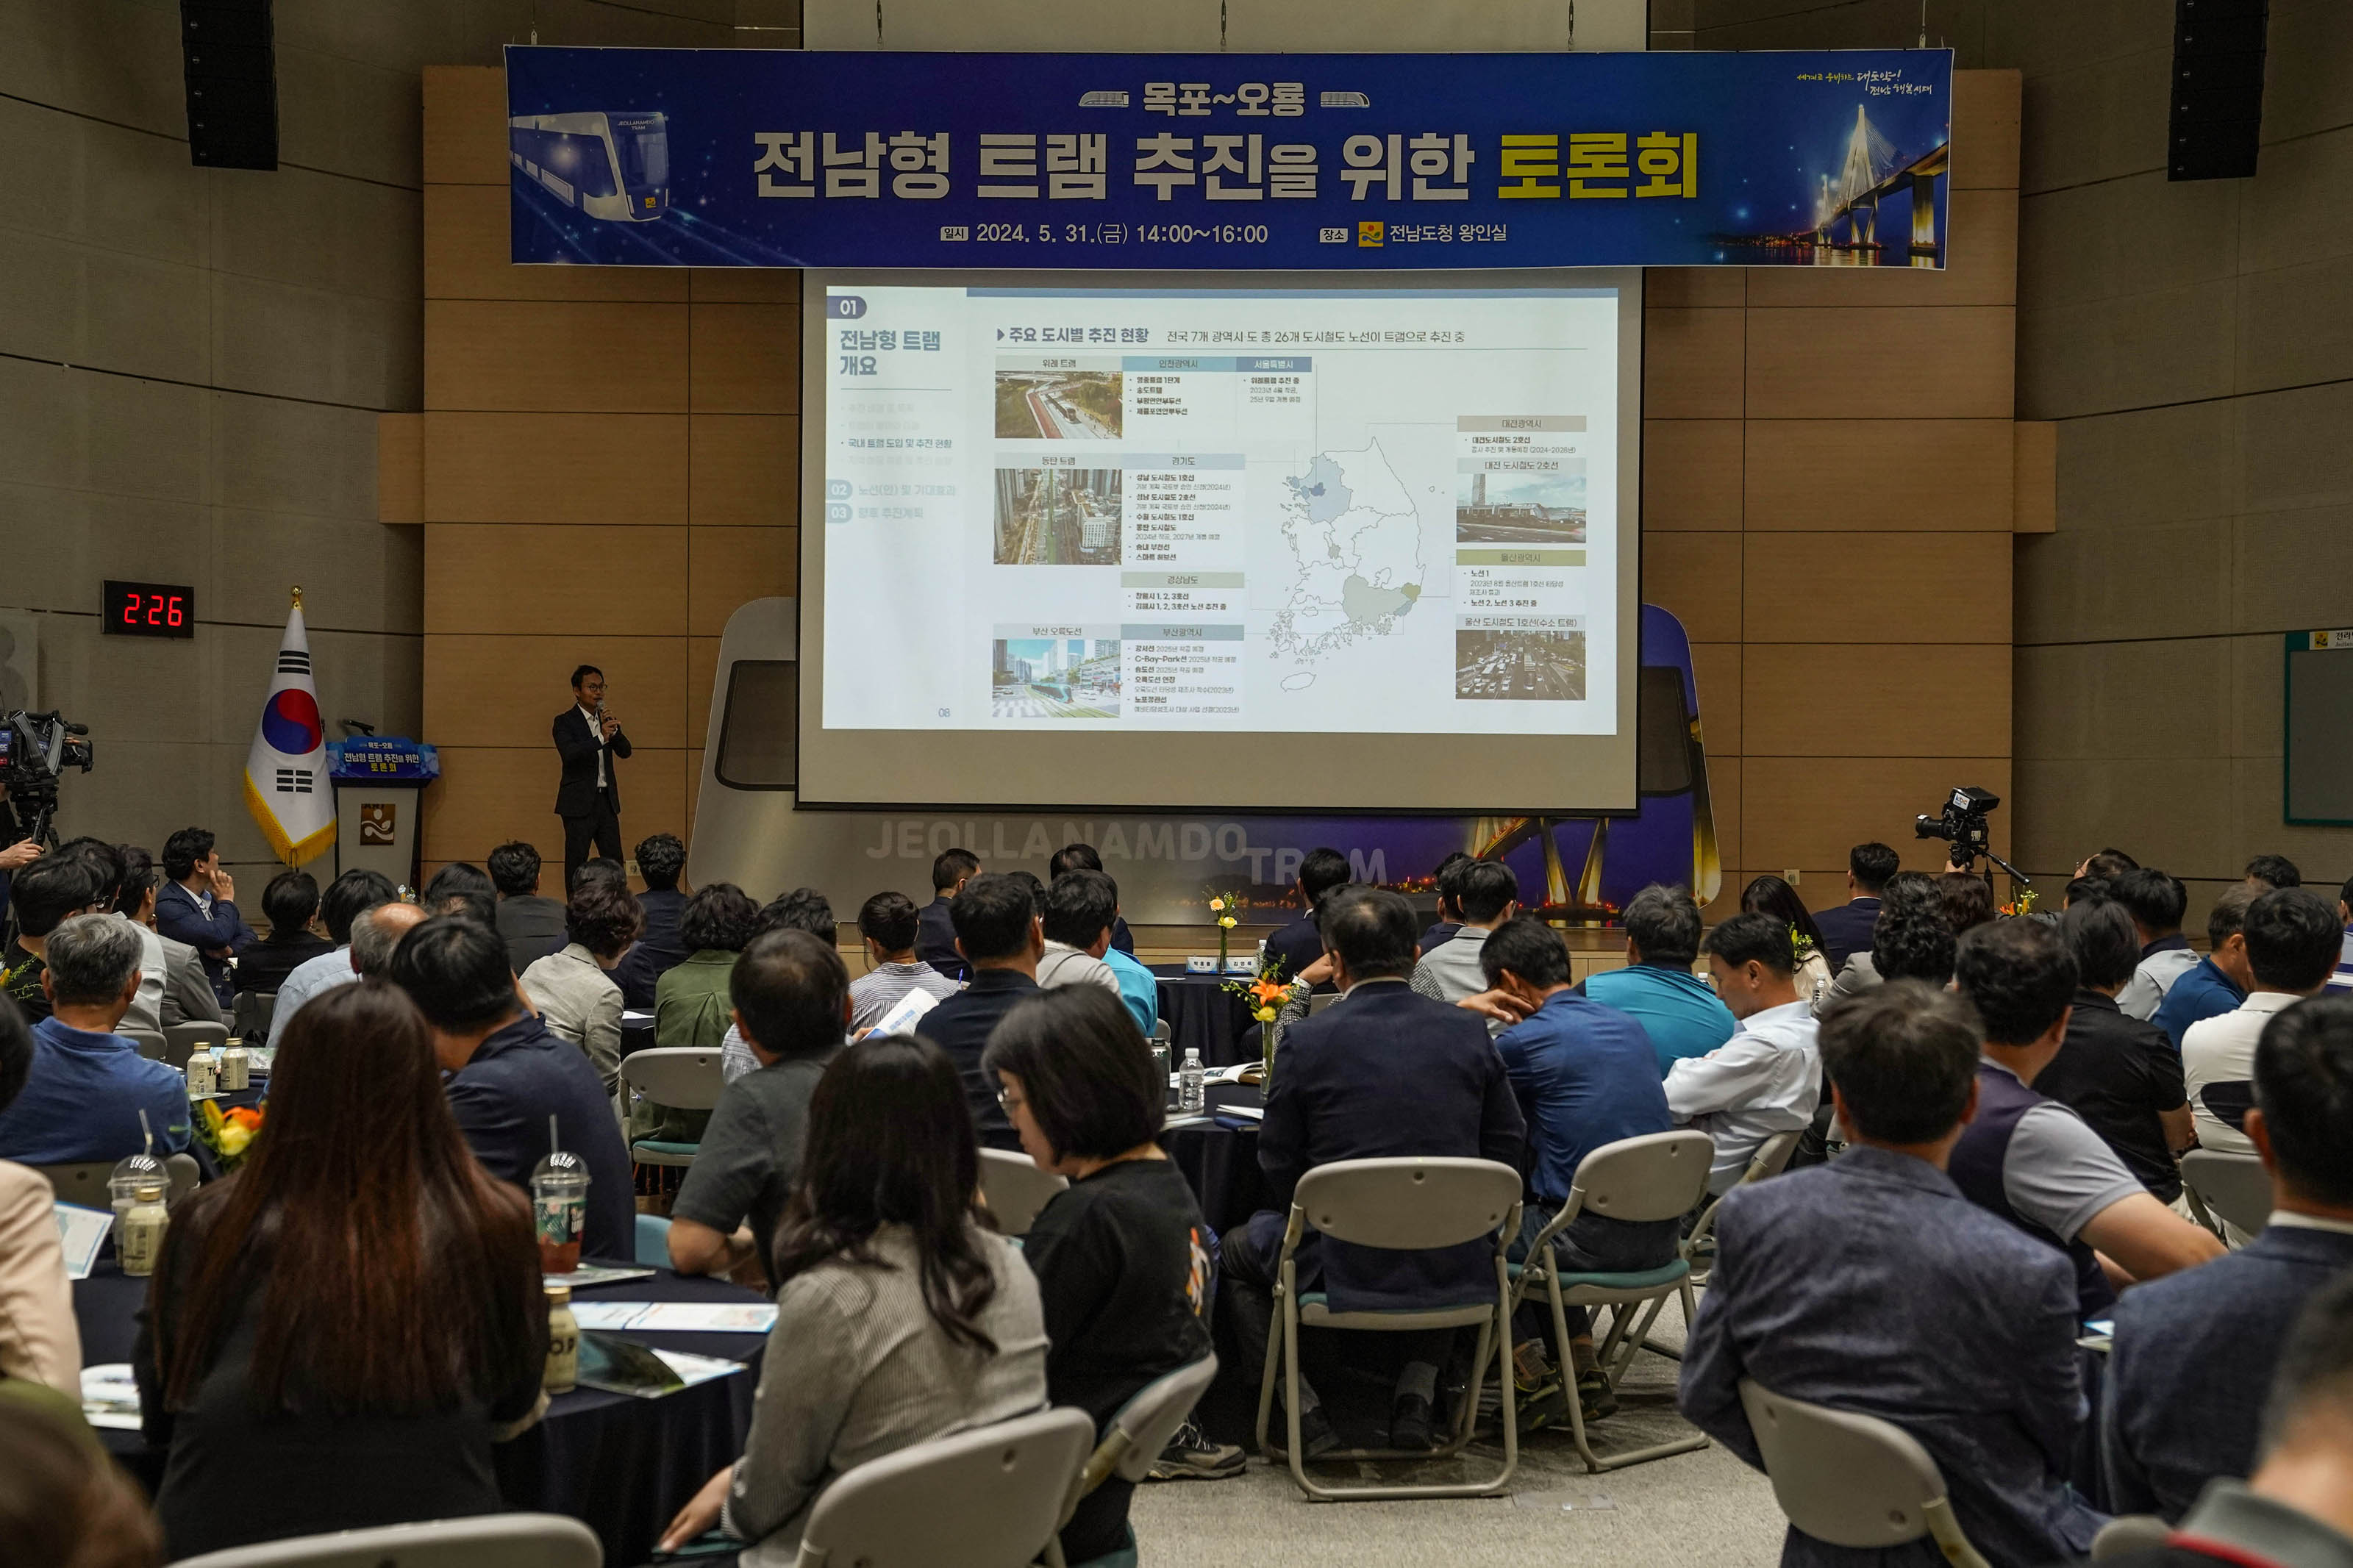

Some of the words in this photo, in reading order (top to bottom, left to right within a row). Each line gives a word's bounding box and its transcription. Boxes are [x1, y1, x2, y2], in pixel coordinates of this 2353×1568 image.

[1142, 82, 1305, 118] 목포~오룡
[752, 131, 951, 201] 전남형
[977, 131, 1107, 201] 트램
[1132, 131, 1318, 201] 추진을
[1340, 131, 1474, 201] 위한
[1497, 131, 1699, 201] 토론회
[943, 227, 965, 240] 일시
[976, 223, 1029, 243] 2024.
[1038, 223, 1057, 243] 5.
[1137, 223, 1268, 243] 14:00~16:00
[1323, 229, 1345, 240] 장소
[1390, 224, 1453, 243] 전남도청
[1458, 224, 1507, 243] 왕인실
[840, 300, 857, 315] 01
[840, 330, 896, 351] 전남형
[903, 330, 940, 351] 트램
[1009, 327, 1036, 343] 주요
[1042, 327, 1084, 343] 도시별
[1088, 327, 1117, 343] 추진
[1121, 327, 1149, 343] 현황
[1167, 331, 1188, 343] 전국
[1190, 331, 1208, 343] 7개
[1261, 331, 1271, 343] 총
[1274, 331, 1299, 343] 26개
[1303, 331, 1345, 343] 도시철도
[1349, 331, 1380, 343] 노선이
[1384, 331, 1427, 343] 트램으로
[1430, 331, 1451, 343] 추진
[1454, 331, 1465, 343] 중
[840, 356, 877, 376] 개요
[1502, 419, 1542, 428] 대전광역시
[1172, 457, 1196, 466] 경기도
[1485, 462, 1501, 470] 대전
[1504, 462, 1535, 470] 도시철도
[1537, 462, 1559, 470] 2호선
[124, 594, 182, 626] 2:26
[1032, 627, 1048, 637] 부산
[1163, 628, 1202, 637] 부산광역시
[938, 708, 951, 717] 08
[344, 753, 366, 763] 전남형
[368, 753, 383, 763] 트램
[405, 753, 419, 763] 위한
[865, 820, 1249, 862] JEOLLANAMDO
[1246, 848, 1388, 887] TRM
